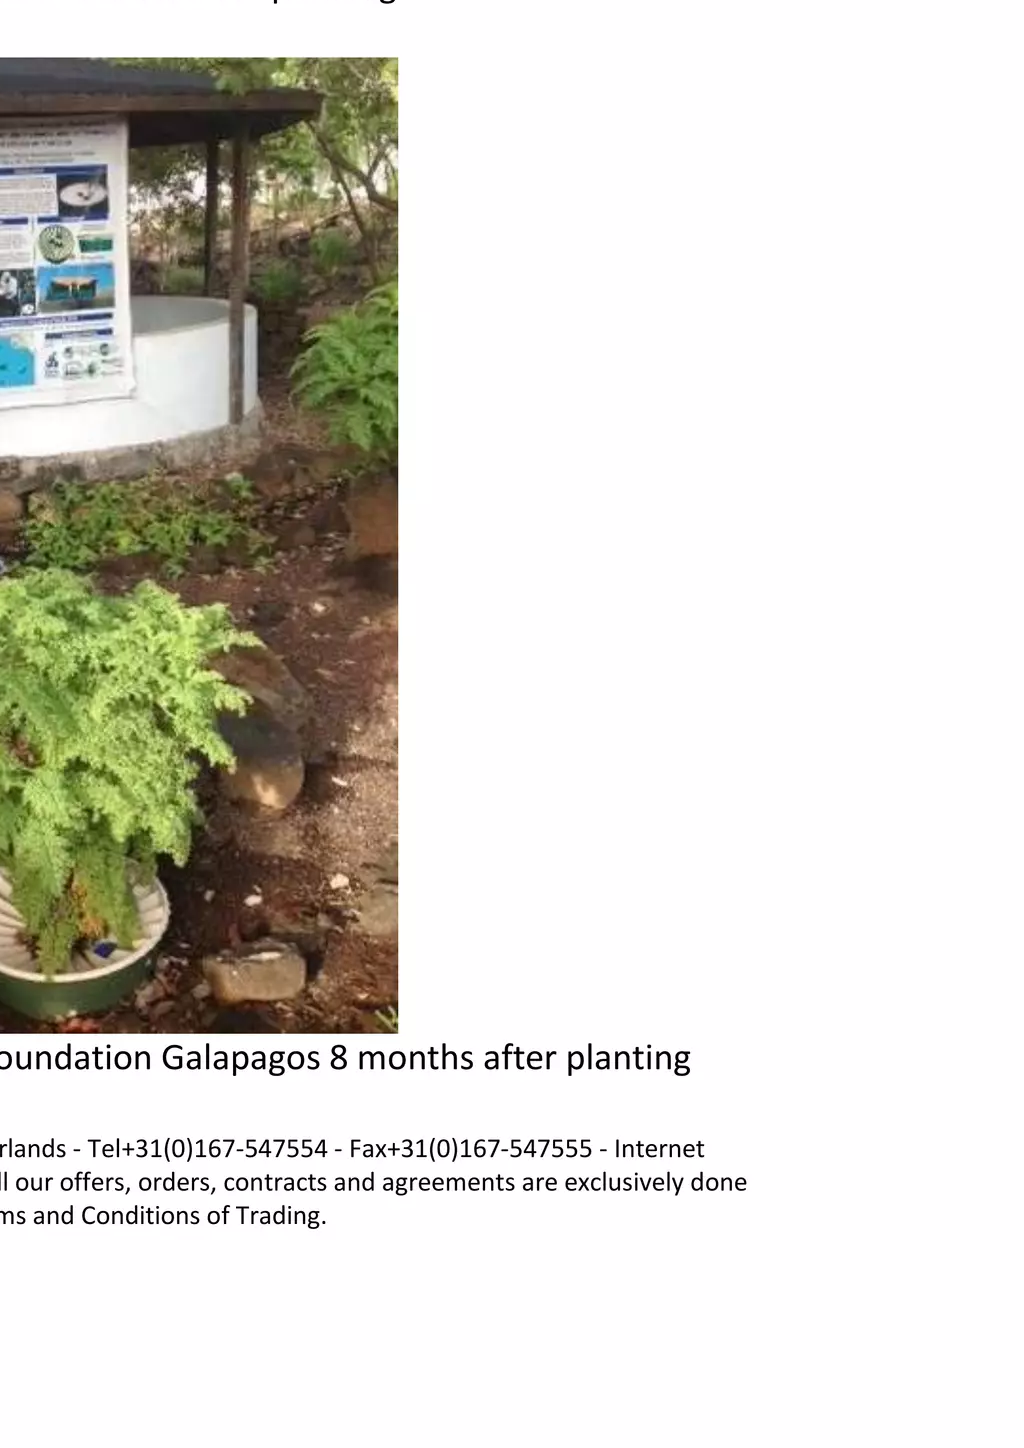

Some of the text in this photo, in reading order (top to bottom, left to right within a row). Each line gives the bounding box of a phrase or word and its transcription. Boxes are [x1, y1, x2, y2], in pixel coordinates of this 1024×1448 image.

[162, 1042, 321, 1077] Galapagos
[330, 1044, 348, 1071] 8
[358, 1042, 474, 1071] months
[484, 1042, 558, 1071] after
[567, 1042, 691, 1077] planting
[87, 1137, 328, 1163] Tel+31(0)167-547554
[350, 1137, 592, 1163] Fax+31(0)167-547555
[615, 1138, 705, 1159] Internet
[15, 1176, 54, 1192] our
[60, 1170, 131, 1196] offers,
[138, 1171, 216, 1196] orders,
[223, 1173, 327, 1192] contracts
[334, 1171, 375, 1192] and
[382, 1173, 516, 1197] agreements
[522, 1176, 558, 1192] are
[564, 1171, 685, 1197] exclusively
[690, 1171, 748, 1192] done
[33, 1204, 74, 1225] and
[81, 1204, 200, 1225] Conditions
[207, 1204, 231, 1225] of
[235, 1204, 326, 1230] Trading.
